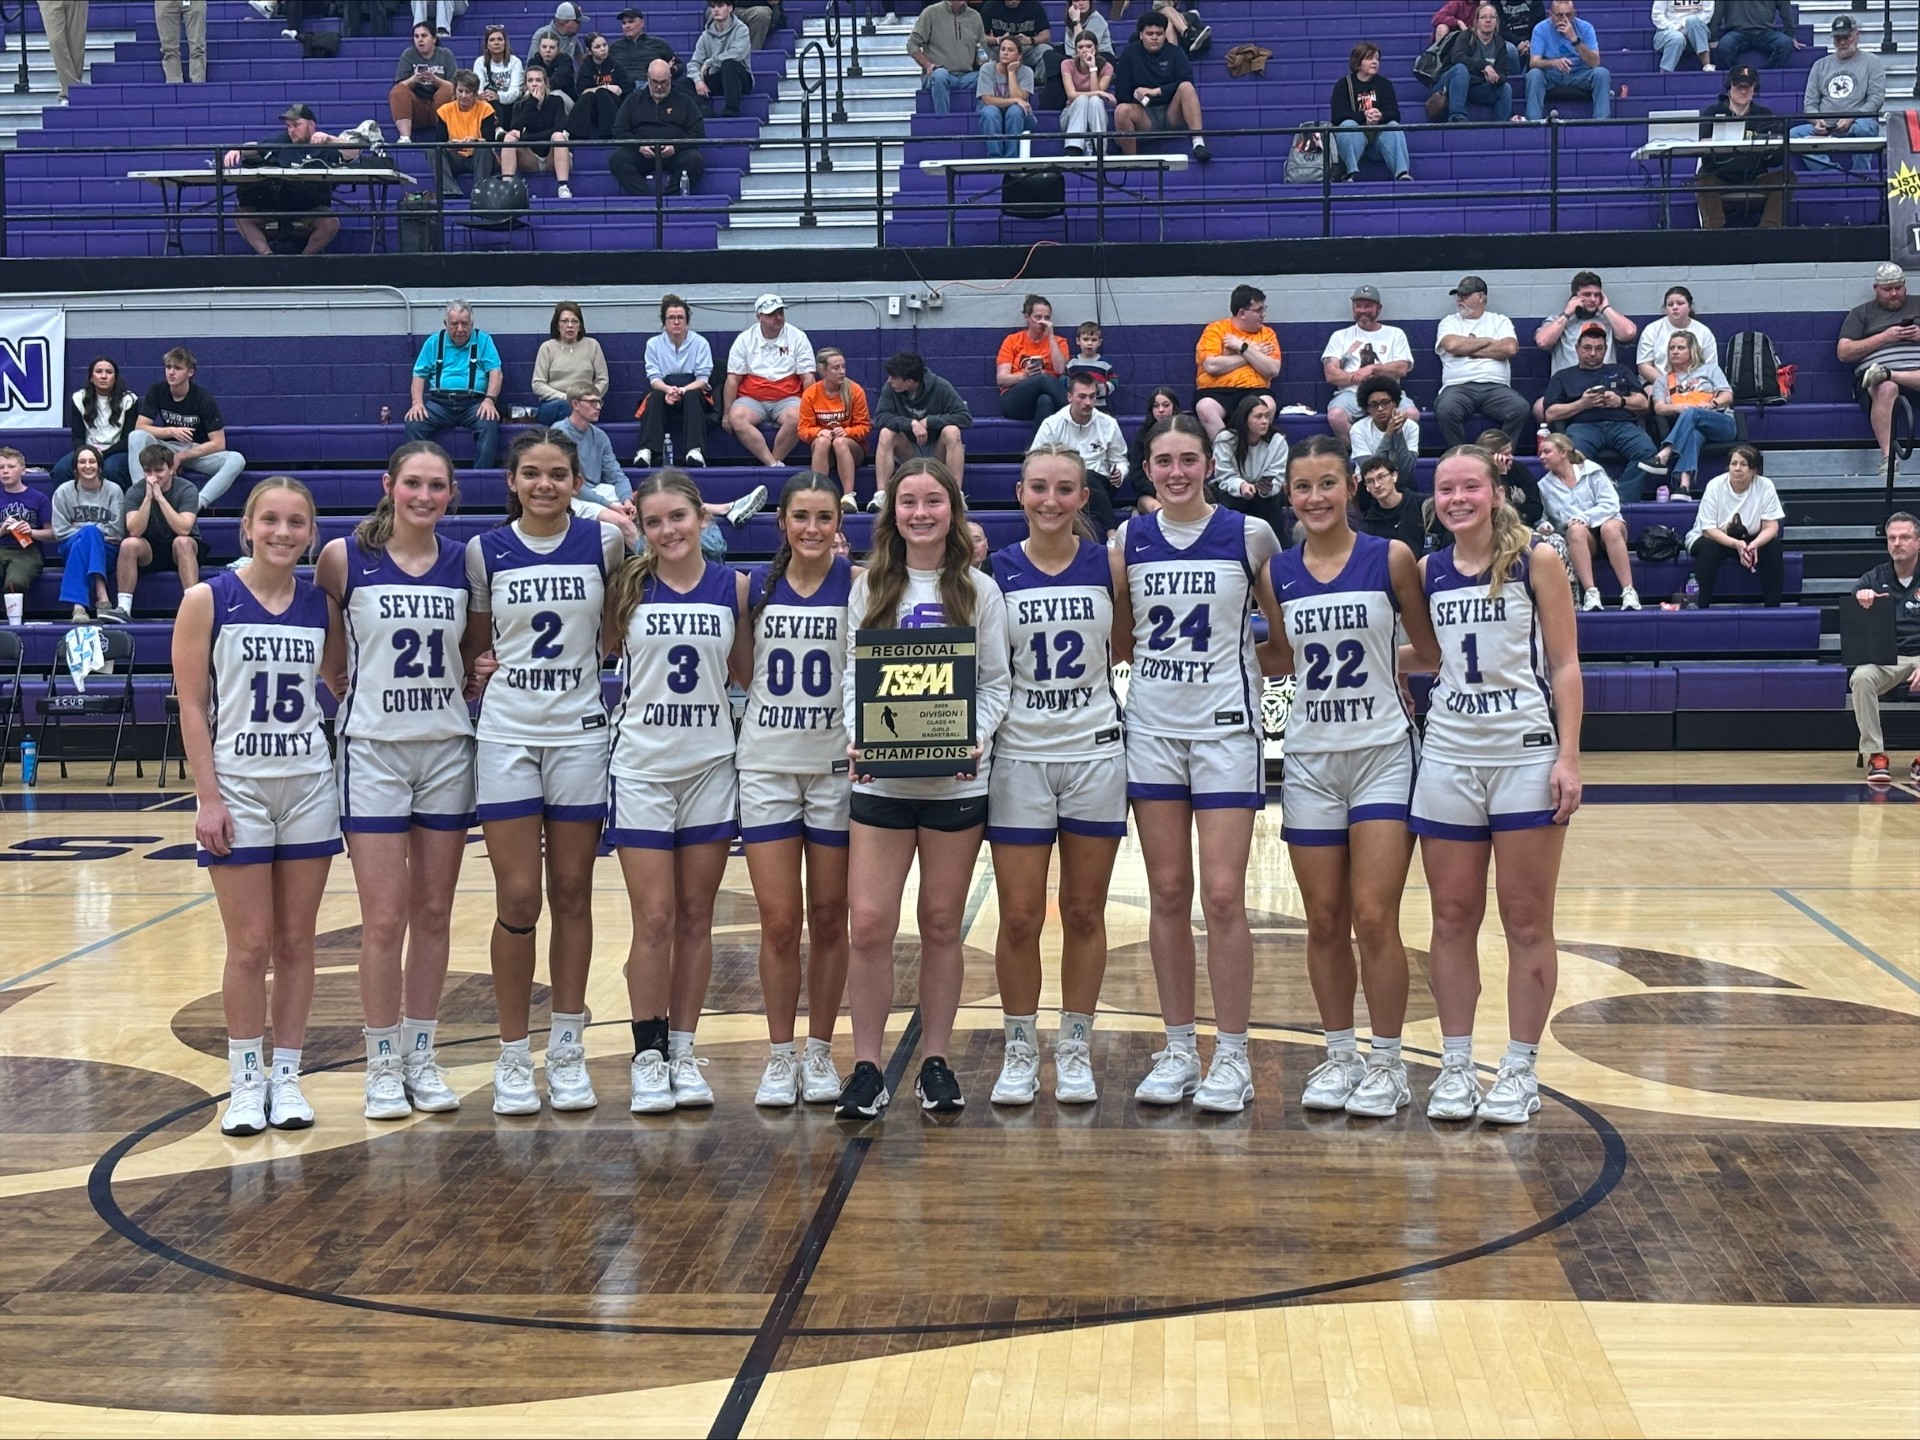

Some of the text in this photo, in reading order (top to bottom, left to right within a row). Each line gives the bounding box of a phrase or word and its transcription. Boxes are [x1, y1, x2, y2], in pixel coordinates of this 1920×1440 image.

[1891, 173, 1920, 190] LIST
[507, 576, 587, 605] SEVIER
[1144, 571, 1216, 597] SEVIER
[379, 594, 455, 621] SEVIER
[1019, 597, 1095, 625] SEVIER
[1294, 603, 1368, 635] SEVIER
[1437, 596, 1507, 627] SEVIER
[531, 610, 564, 660] 2
[646, 613, 721, 638] SEVIER
[764, 615, 837, 641] SEVIER
[1148, 603, 1213, 652] 24
[242, 636, 315, 664] SEVIER
[391, 628, 446, 679] 21
[871, 644, 958, 657] REGIONAL
[1030, 629, 1086, 682] 12
[1461, 632, 1484, 685] 1
[667, 644, 701, 694] 3
[767, 647, 833, 698] 00
[1141, 656, 1215, 683] COUNTY
[1304, 639, 1368, 691] 22
[506, 667, 583, 692] COUNTY
[876, 662, 954, 697] TSSAA
[249, 671, 306, 723] 15
[1026, 686, 1093, 711] COUNTY
[1446, 687, 1518, 715] COUNTY
[643, 703, 720, 727] COUNTY
[758, 705, 837, 730] COUNTY
[919, 710, 958, 718] DIVISION
[234, 732, 312, 757] COUNTY
[863, 747, 968, 760] CHAMPIONS
